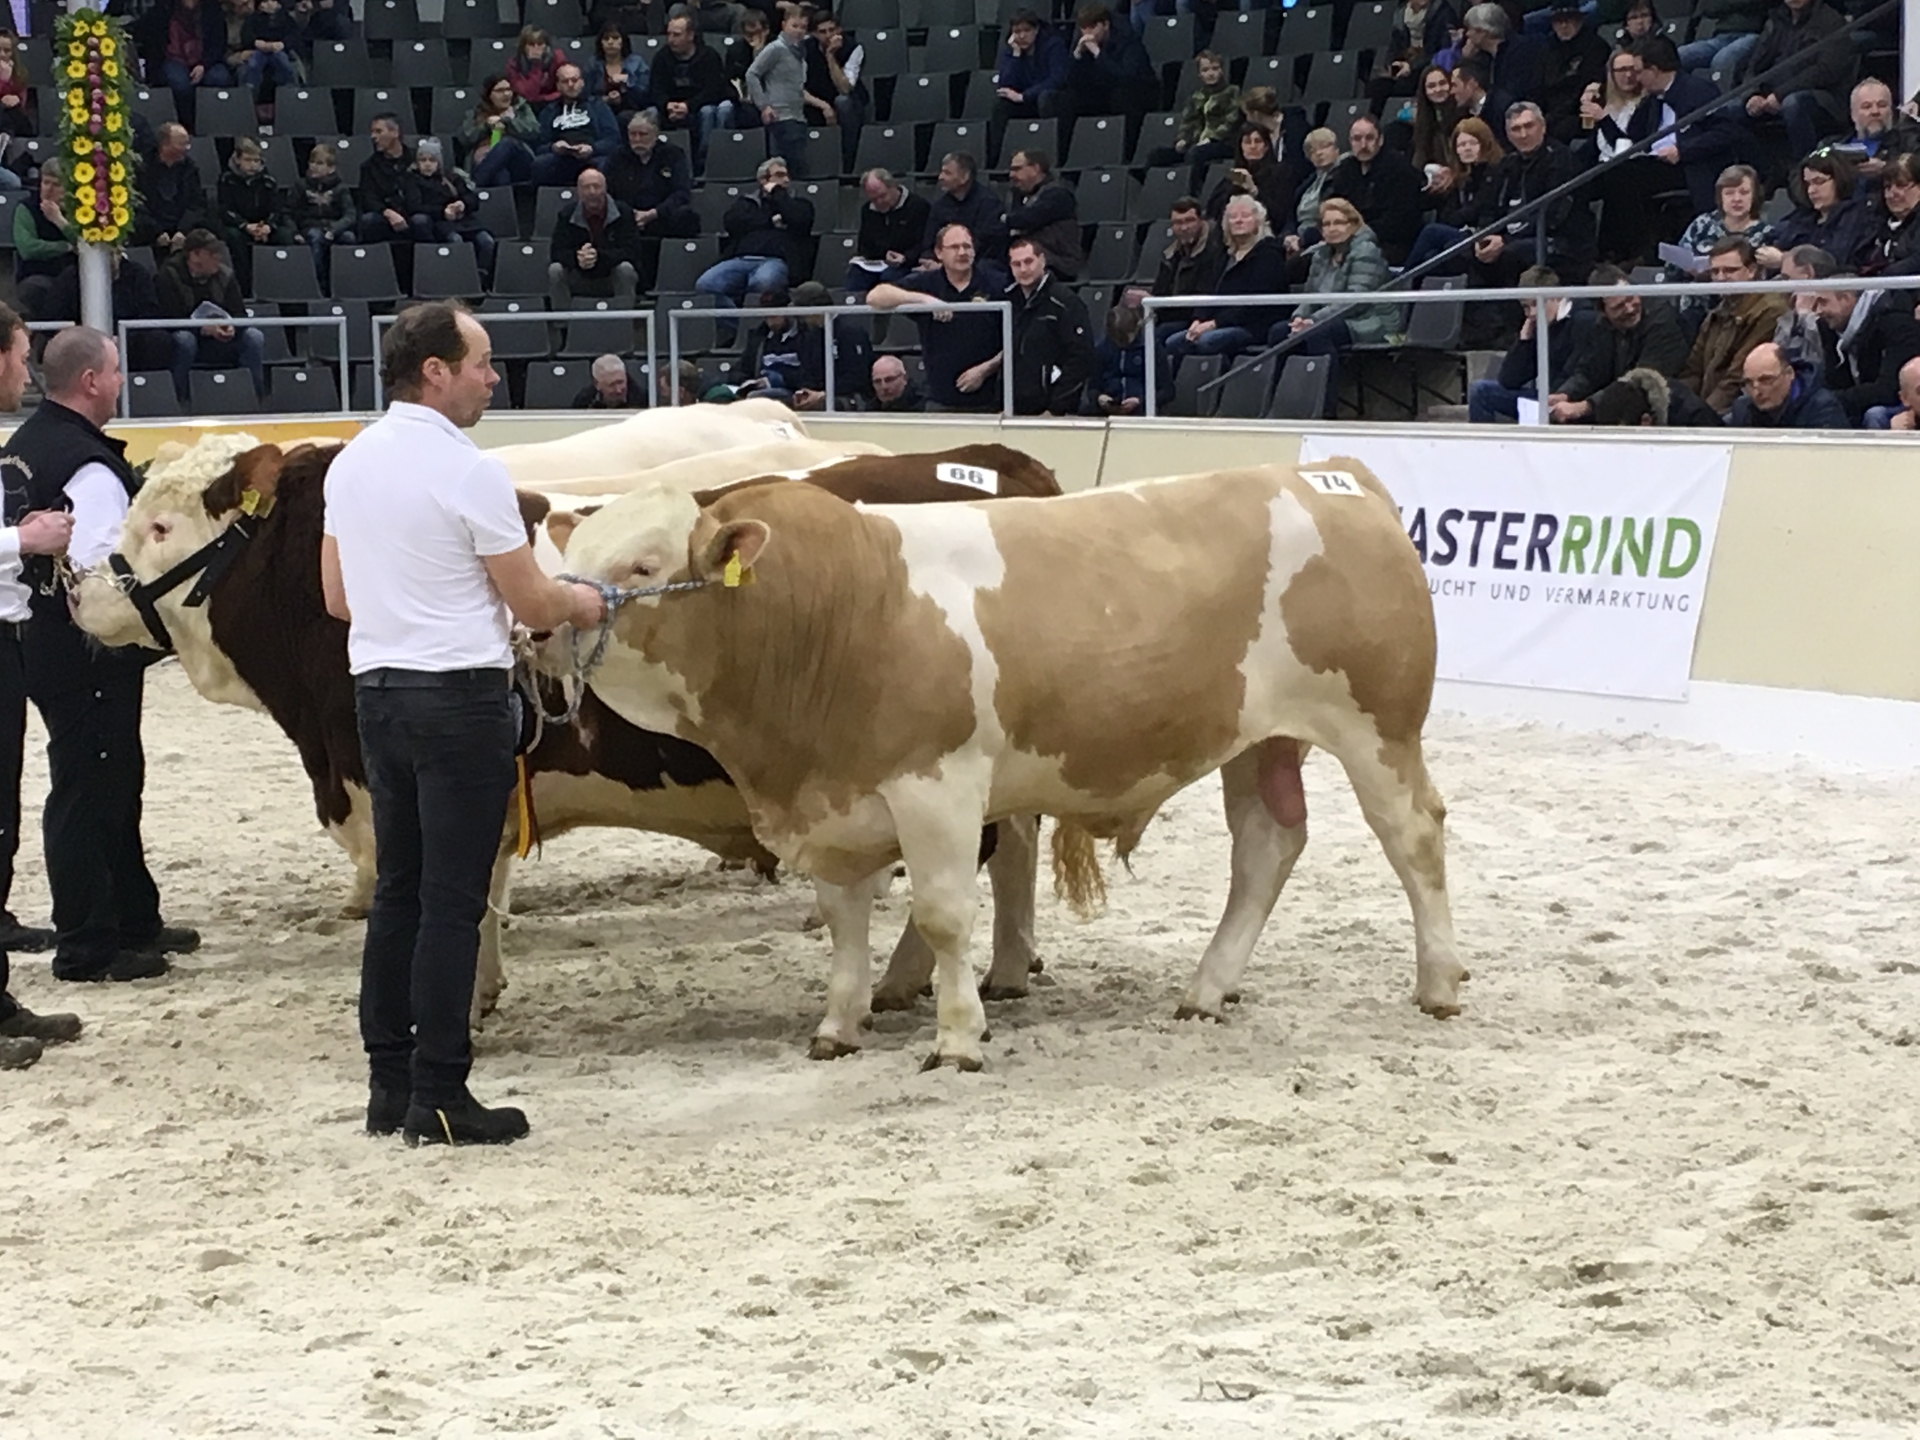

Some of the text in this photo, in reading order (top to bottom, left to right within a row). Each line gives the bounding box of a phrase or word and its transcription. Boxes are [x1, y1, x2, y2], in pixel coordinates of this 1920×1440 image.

[1311, 475, 1352, 491] 74
[1399, 506, 1702, 578] ASTERRIND
[1430, 578, 1690, 612] UCHT UND VERMARKTUNG
